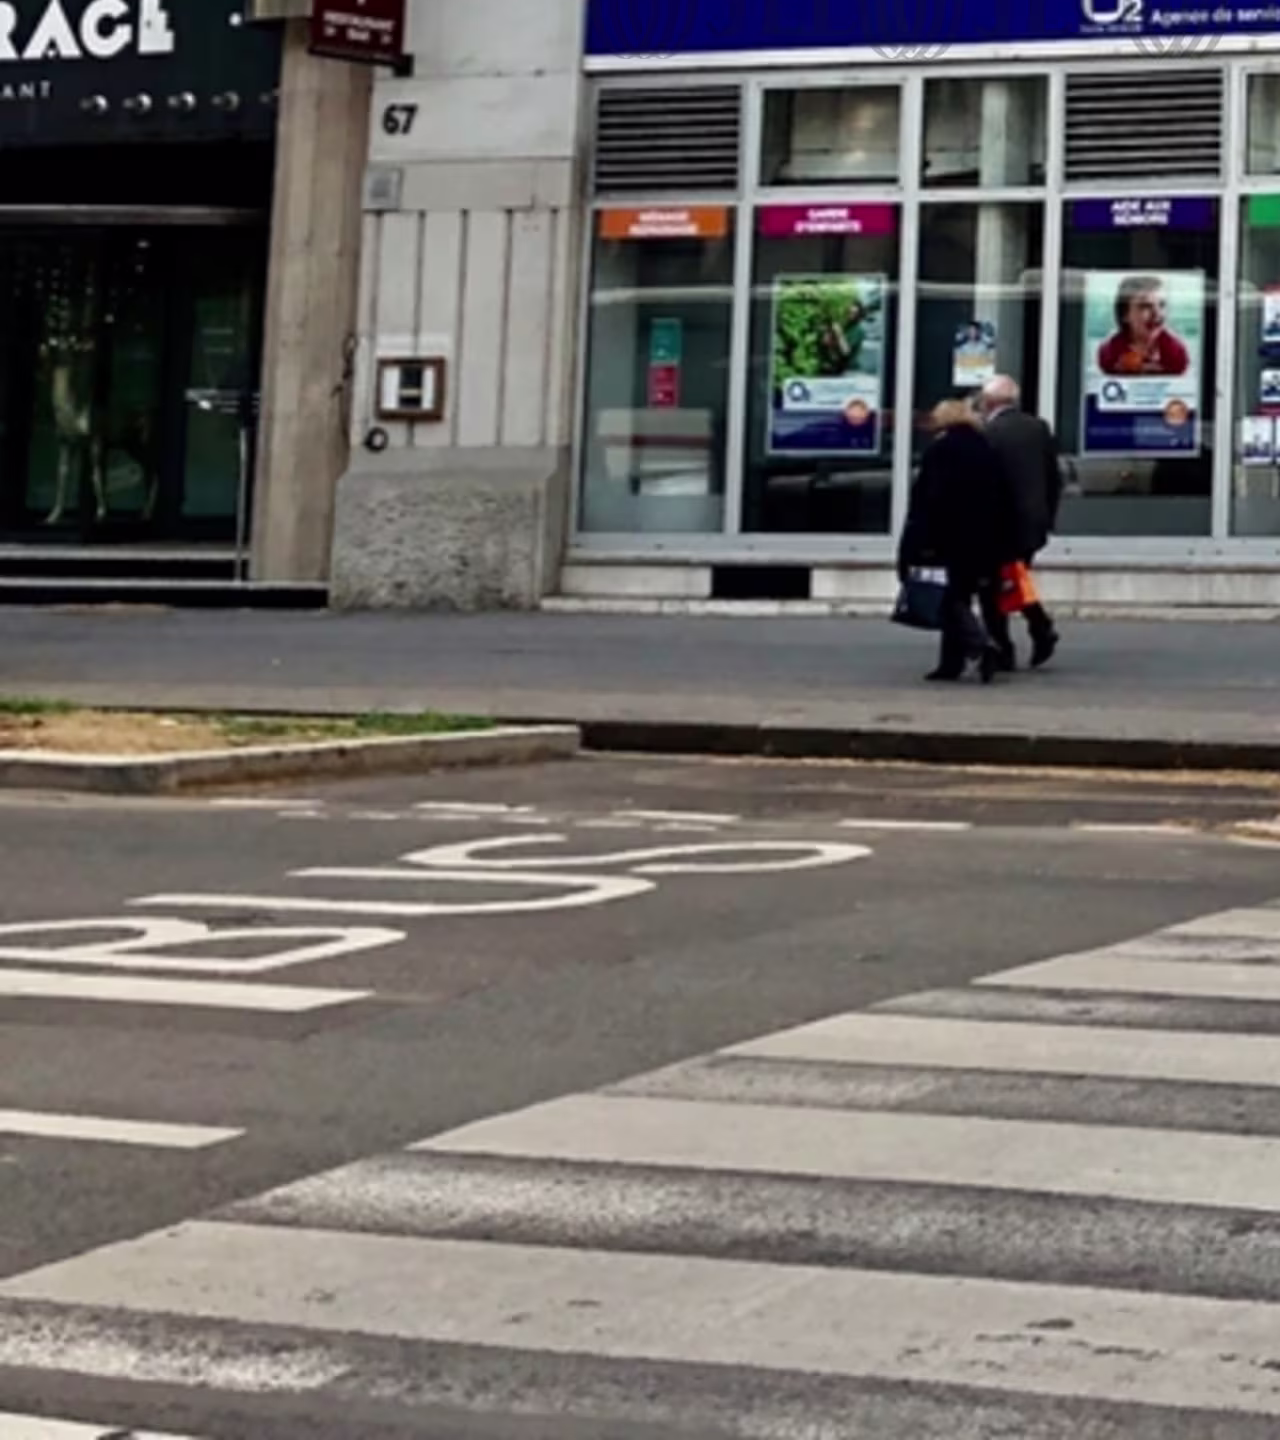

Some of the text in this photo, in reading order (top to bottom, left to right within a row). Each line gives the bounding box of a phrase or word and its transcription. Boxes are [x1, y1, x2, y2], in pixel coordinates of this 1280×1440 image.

[1151, 7, 1209, 28] Agence
[1213, 6, 1232, 23] de
[382, 104, 418, 135] 67
